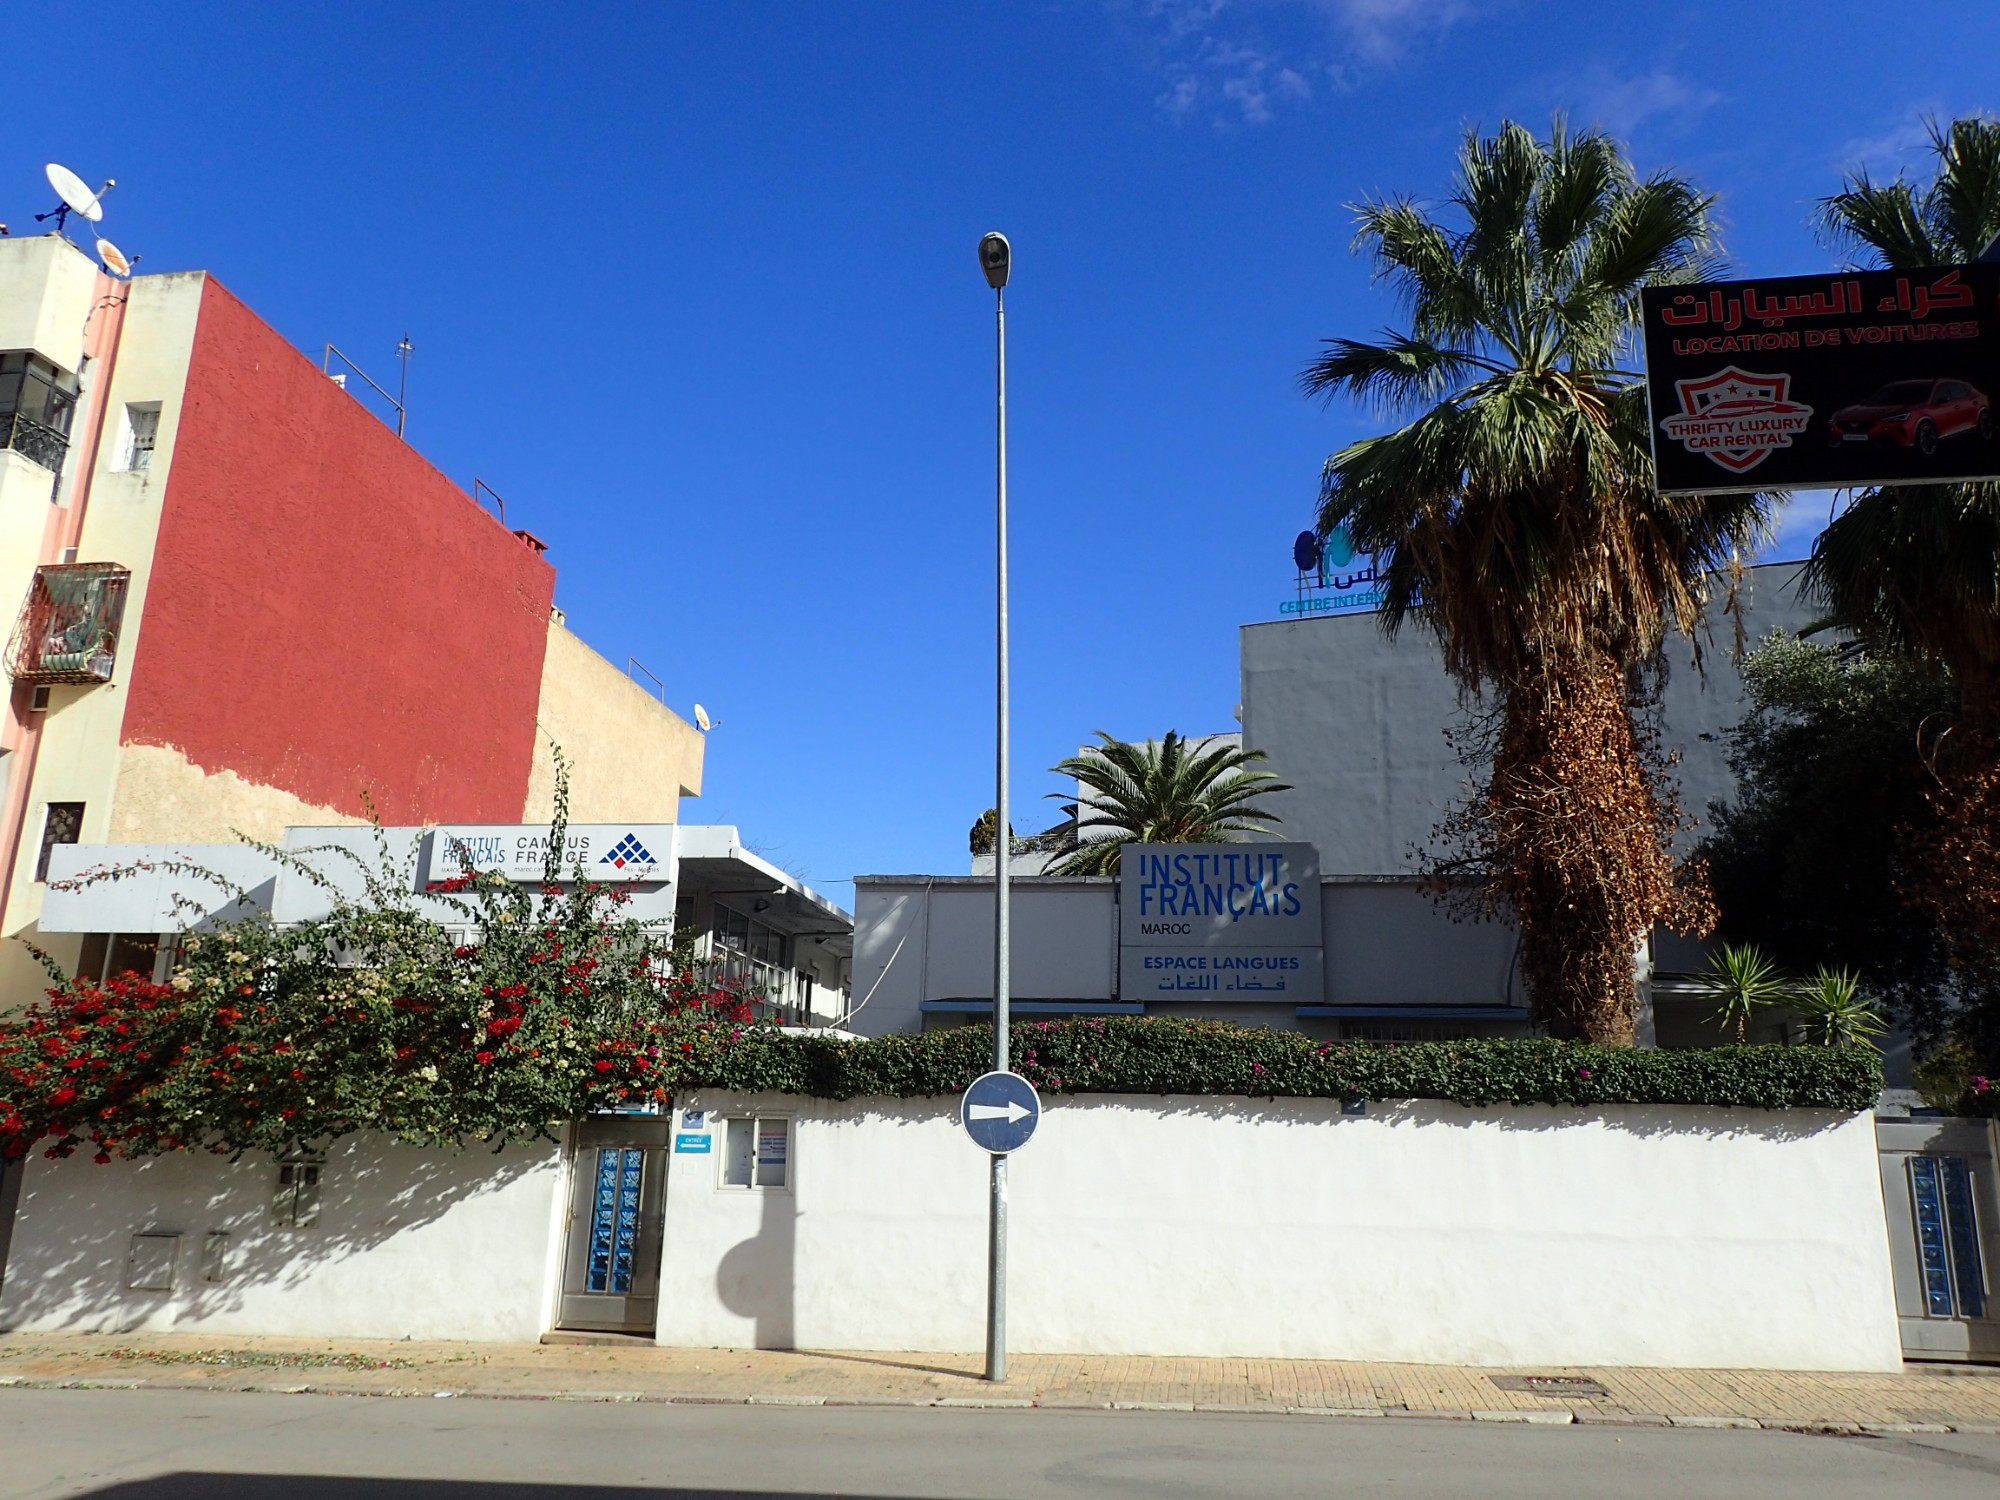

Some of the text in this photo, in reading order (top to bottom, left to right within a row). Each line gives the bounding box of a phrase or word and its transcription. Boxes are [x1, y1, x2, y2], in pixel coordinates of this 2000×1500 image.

[1661, 269, 1974, 331] كراء السيارات
[1673, 320, 1980, 356] LOCATION DE VOITURES
[1668, 417, 1805, 436] THRIFTY LUXURY
[1688, 432, 1788, 449] CAR RENTAL
[1280, 597, 1332, 614] CENTRE
[1140, 853, 1283, 887] INSTITUT
[1140, 883, 1301, 923] FRANÇAIS
[1141, 923, 1192, 935] MAROC
[1144, 957, 1300, 970] ESPACE LANGUES
[1158, 974, 1286, 991] فضاء اللغات
